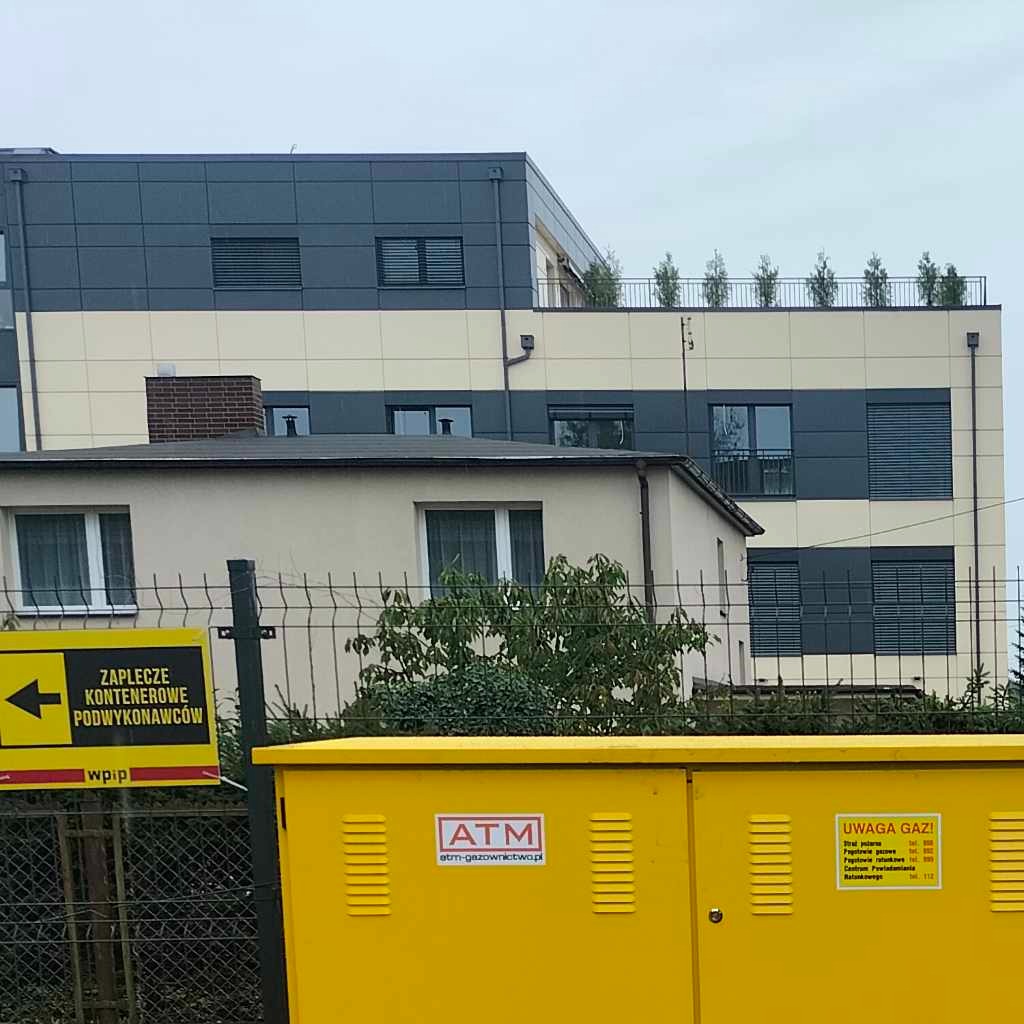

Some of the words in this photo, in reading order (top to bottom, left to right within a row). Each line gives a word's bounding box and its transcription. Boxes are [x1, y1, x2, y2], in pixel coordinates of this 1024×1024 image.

[100, 668, 170, 686] ZAPLECZE
[84, 687, 189, 706] KONTENEROWE
[73, 707, 203, 727] PODWYKONAWCÓW
[87, 768, 128, 784] wpip
[449, 823, 533, 846] ATM
[843, 822, 896, 834] UWAGA
[900, 822, 934, 834] GAZ!
